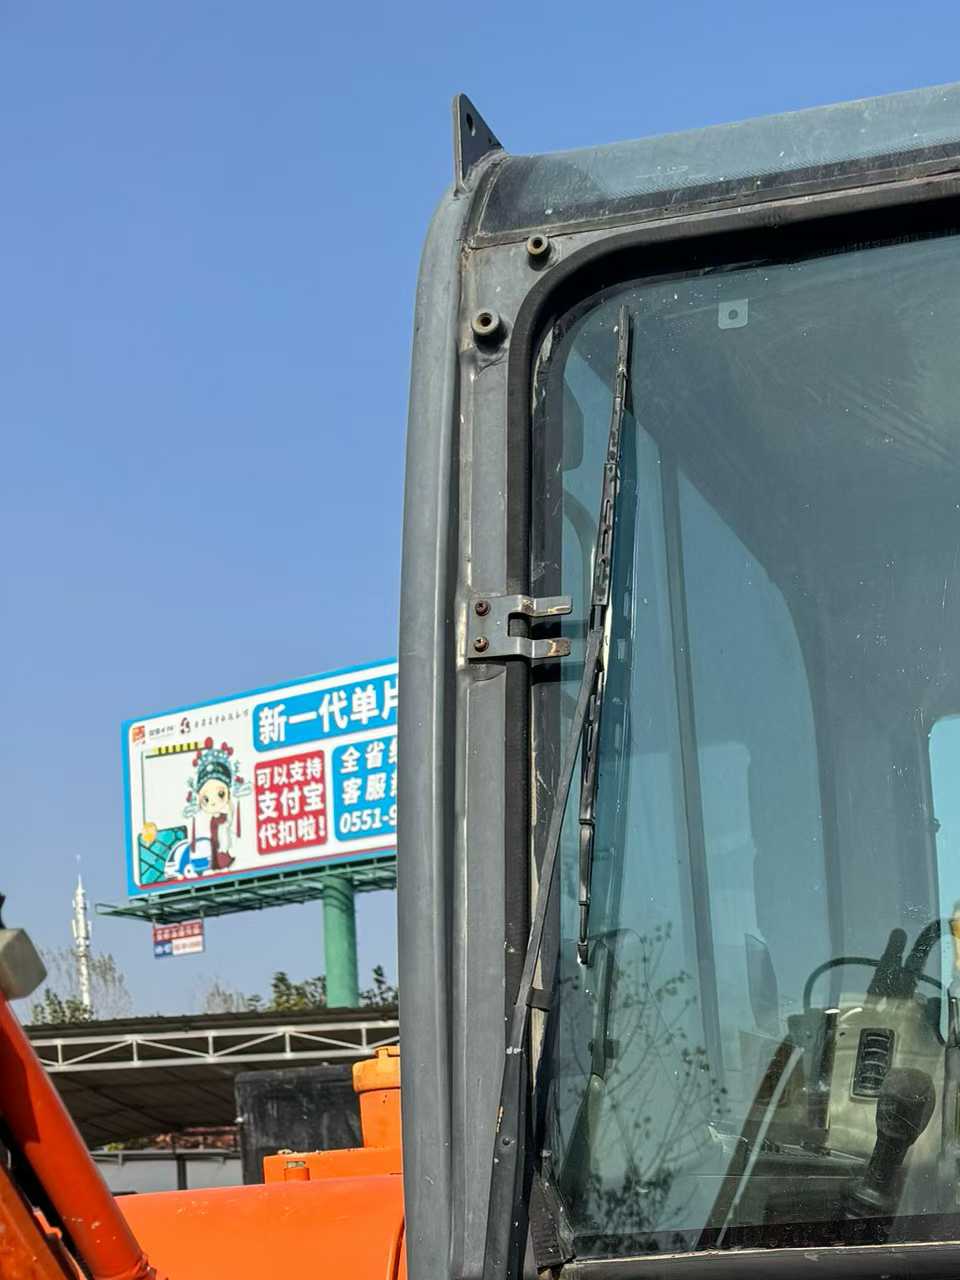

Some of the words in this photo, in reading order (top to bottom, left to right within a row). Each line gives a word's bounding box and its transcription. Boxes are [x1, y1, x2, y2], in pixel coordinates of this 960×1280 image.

[256, 757, 321, 788] 可以支持
[258, 781, 324, 821] 支付宝
